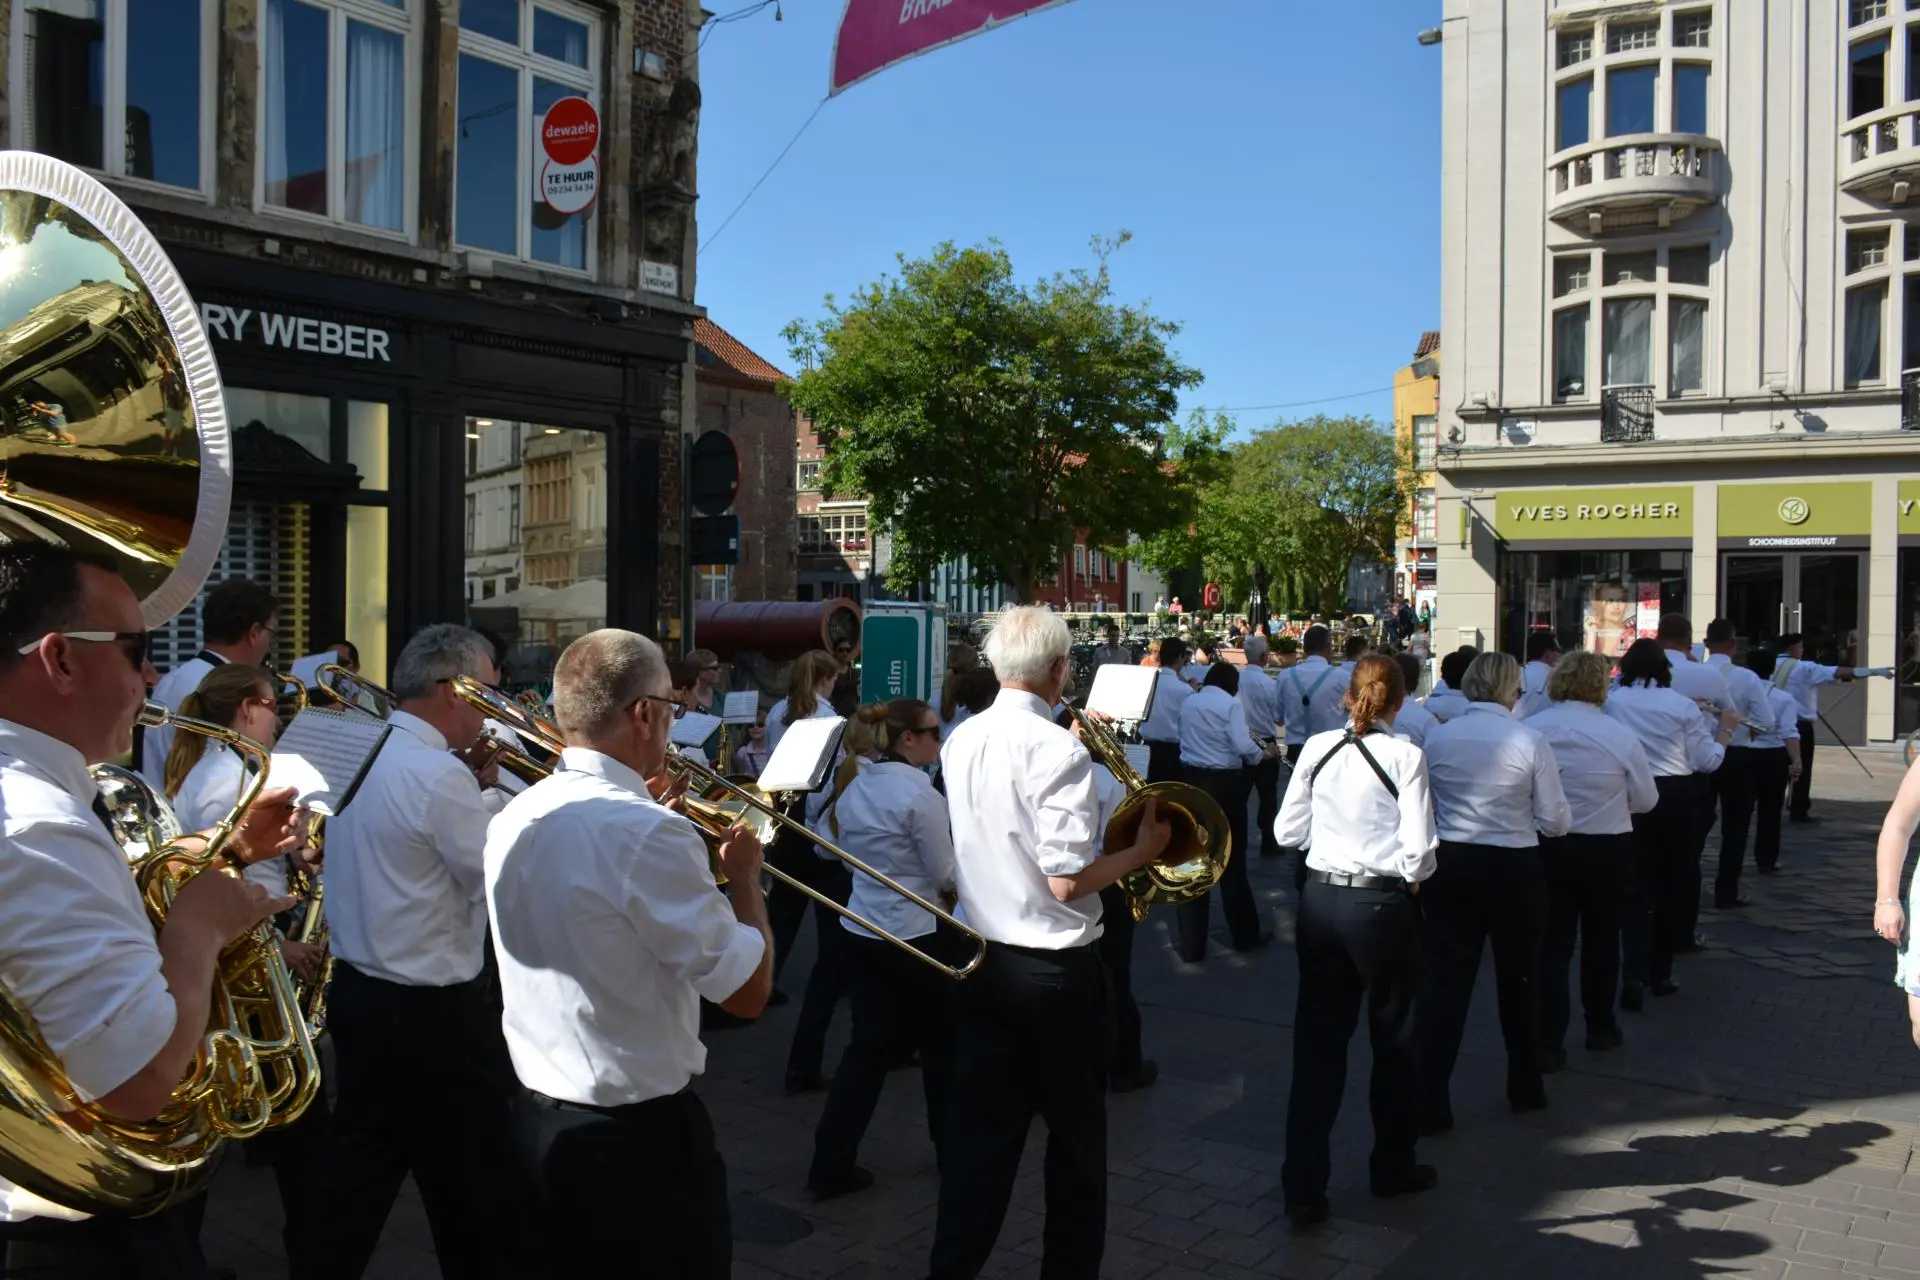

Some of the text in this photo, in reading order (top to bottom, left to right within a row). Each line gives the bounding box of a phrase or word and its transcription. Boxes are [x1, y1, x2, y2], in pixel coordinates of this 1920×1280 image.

[545, 121, 596, 138] dewaele
[547, 171, 594, 184] TE HUUR
[259, 311, 391, 362] WEBER
[1511, 502, 1679, 521] YVES ROCHER
[1898, 499, 1920, 516] Y
[1748, 536, 1838, 546] SCHOONHEIDSINSTITUUT
[887, 660, 902, 695] slim
